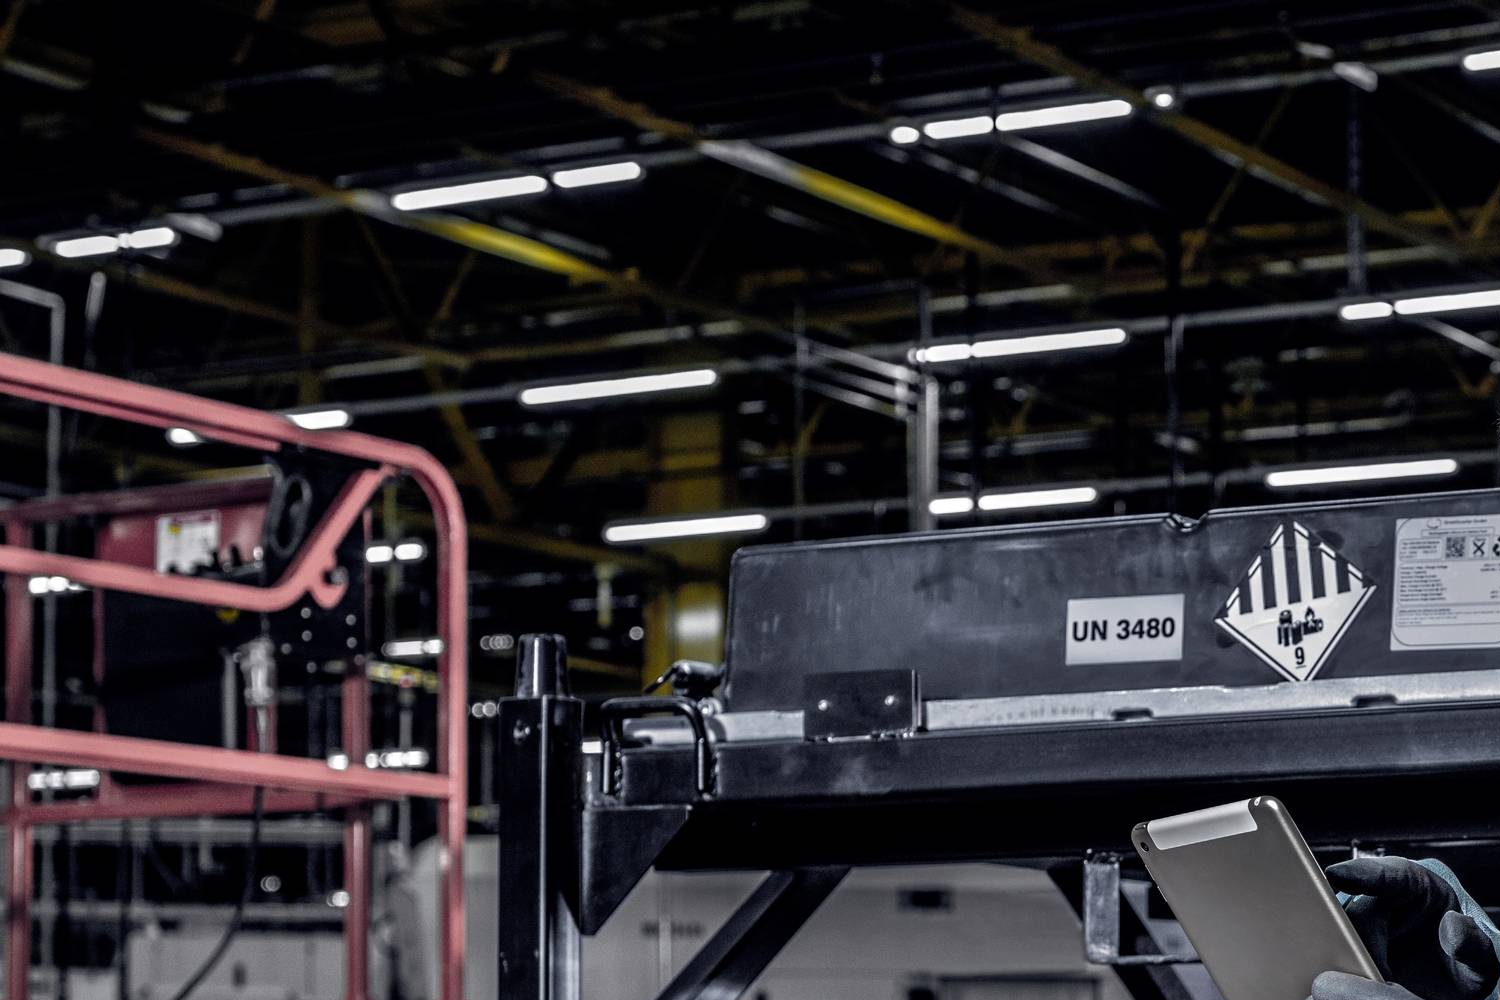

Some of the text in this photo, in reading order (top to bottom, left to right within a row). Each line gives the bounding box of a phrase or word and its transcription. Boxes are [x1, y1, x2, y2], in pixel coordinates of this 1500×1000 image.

[1073, 617, 1175, 642] UN 3480
[1294, 646, 1305, 665] 9
